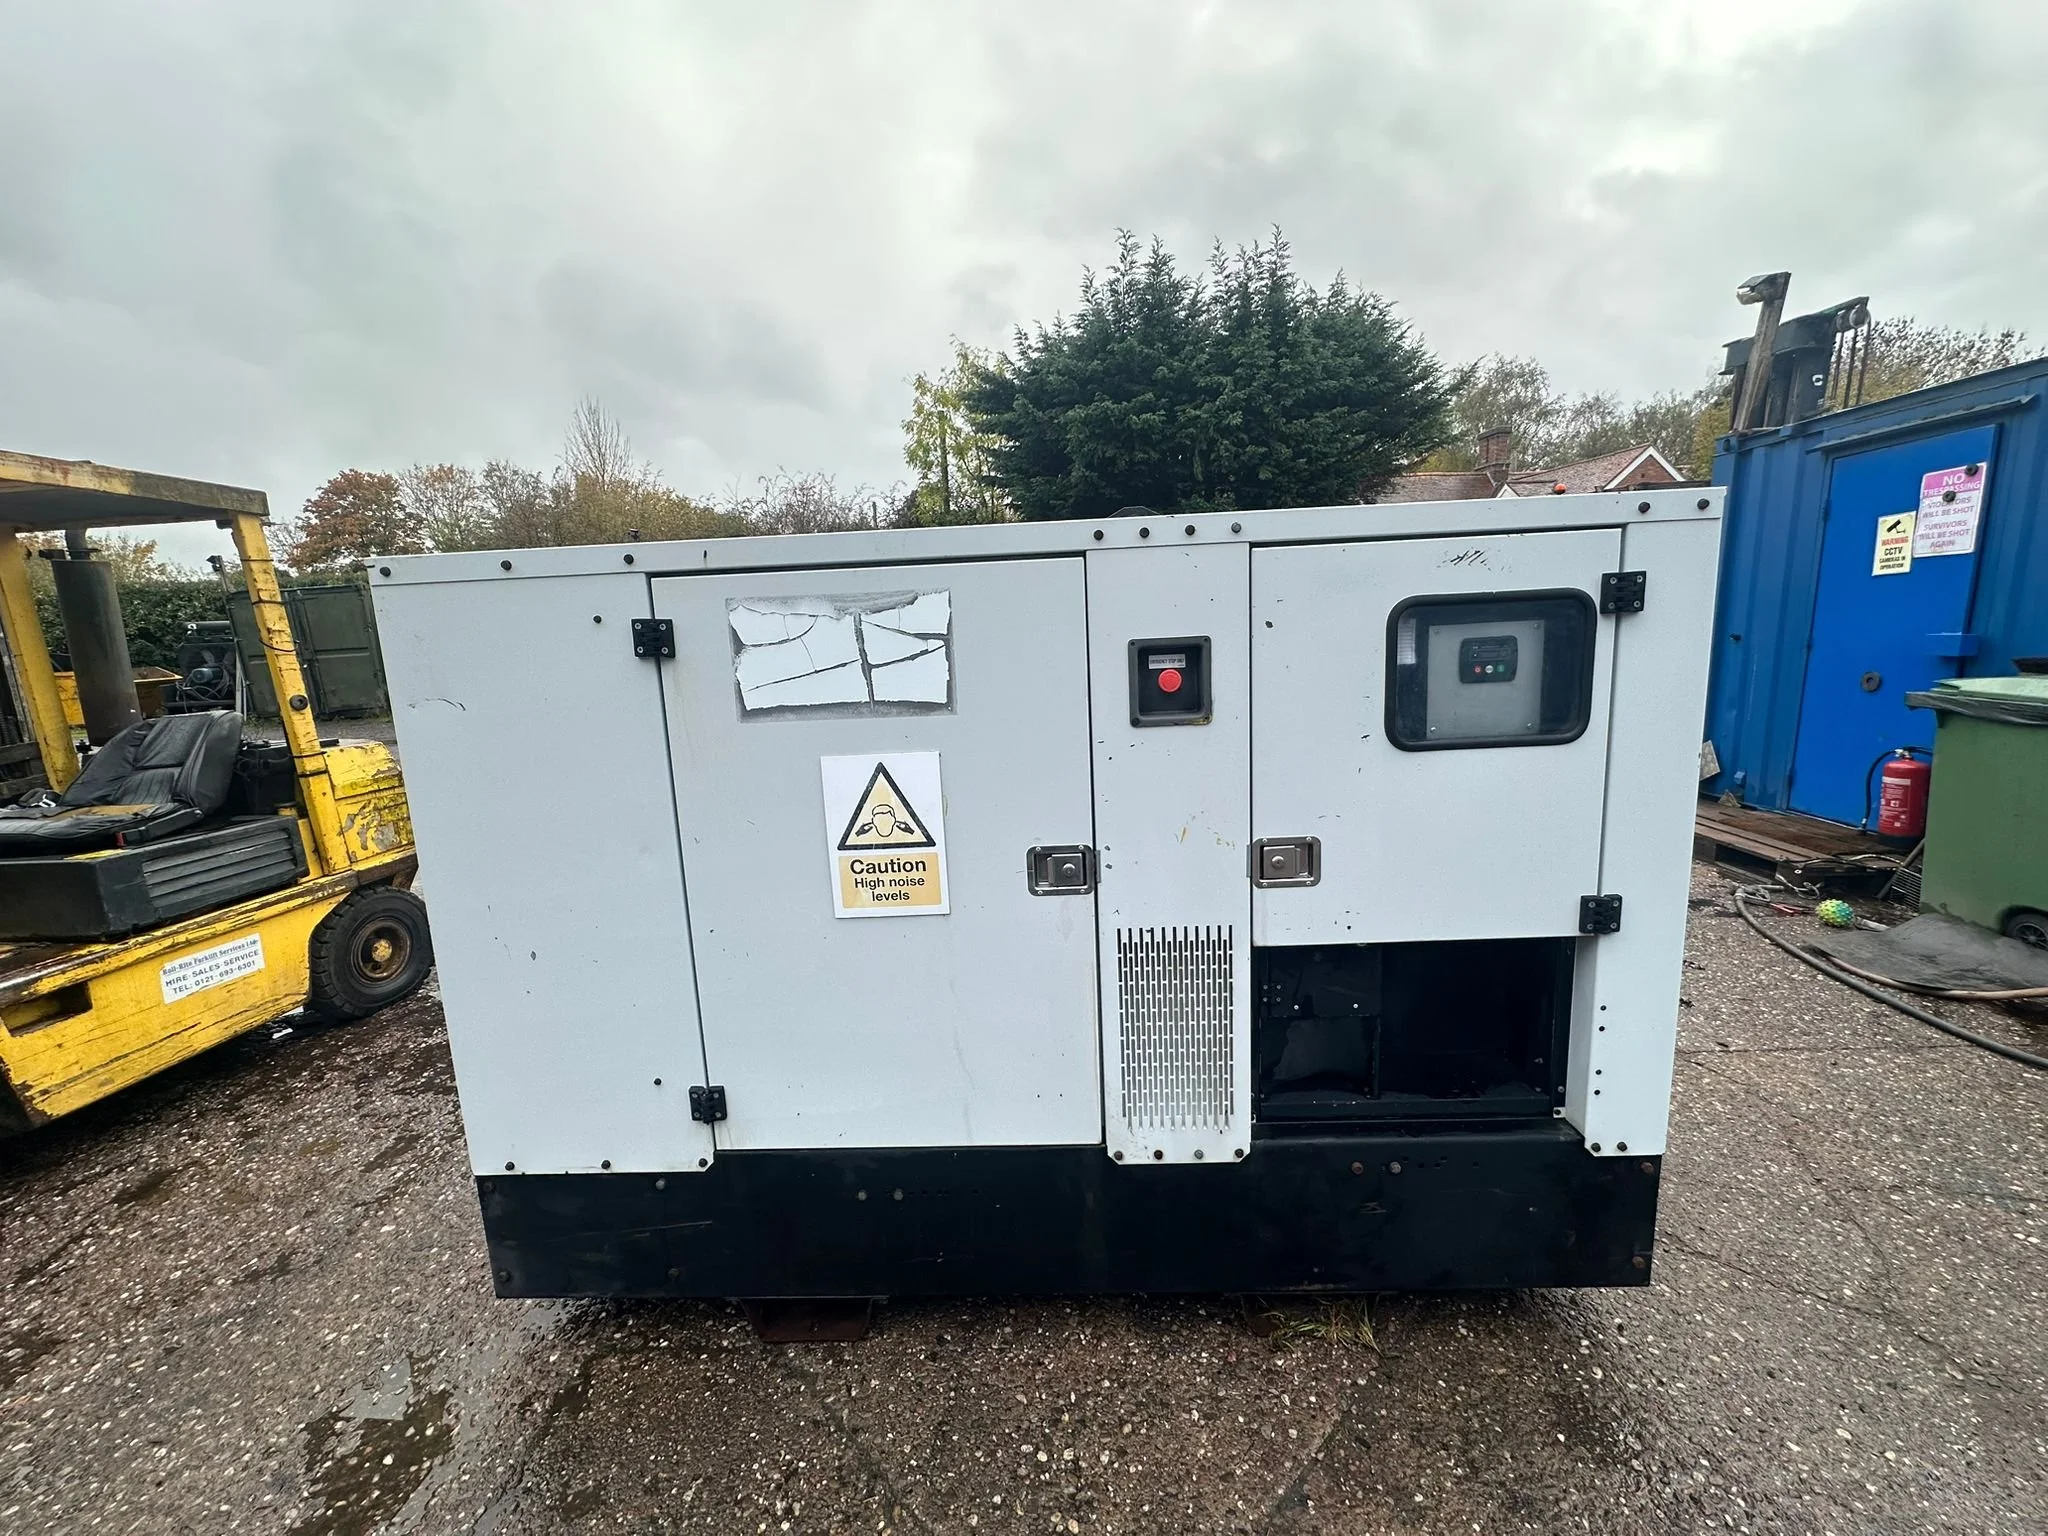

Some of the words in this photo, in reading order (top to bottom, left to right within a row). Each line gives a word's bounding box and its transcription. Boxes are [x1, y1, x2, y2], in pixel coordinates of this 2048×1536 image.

[1942, 473, 1965, 486] NO
[1924, 481, 1981, 496] TRESPASSING
[1922, 510, 1939, 519] WILL
[1941, 509, 1952, 517] BE
[1952, 505, 1975, 515] SHOT
[1924, 520, 1968, 531] SURVIVORS
[1881, 536, 1909, 546] WARNING
[1917, 531, 1938, 541] WILL
[1948, 528, 1970, 538] SHOT
[1930, 539, 1955, 548] AGAIN
[1884, 546, 1903, 556] CCTV
[850, 858, 926, 875] Caution
[854, 877, 885, 890] High
[889, 876, 925, 887] noise
[872, 890, 910, 901] levels
[218, 943, 246, 957] Services
[223, 949, 260, 967] SERVICE
[173, 983, 193, 994] TEL:
